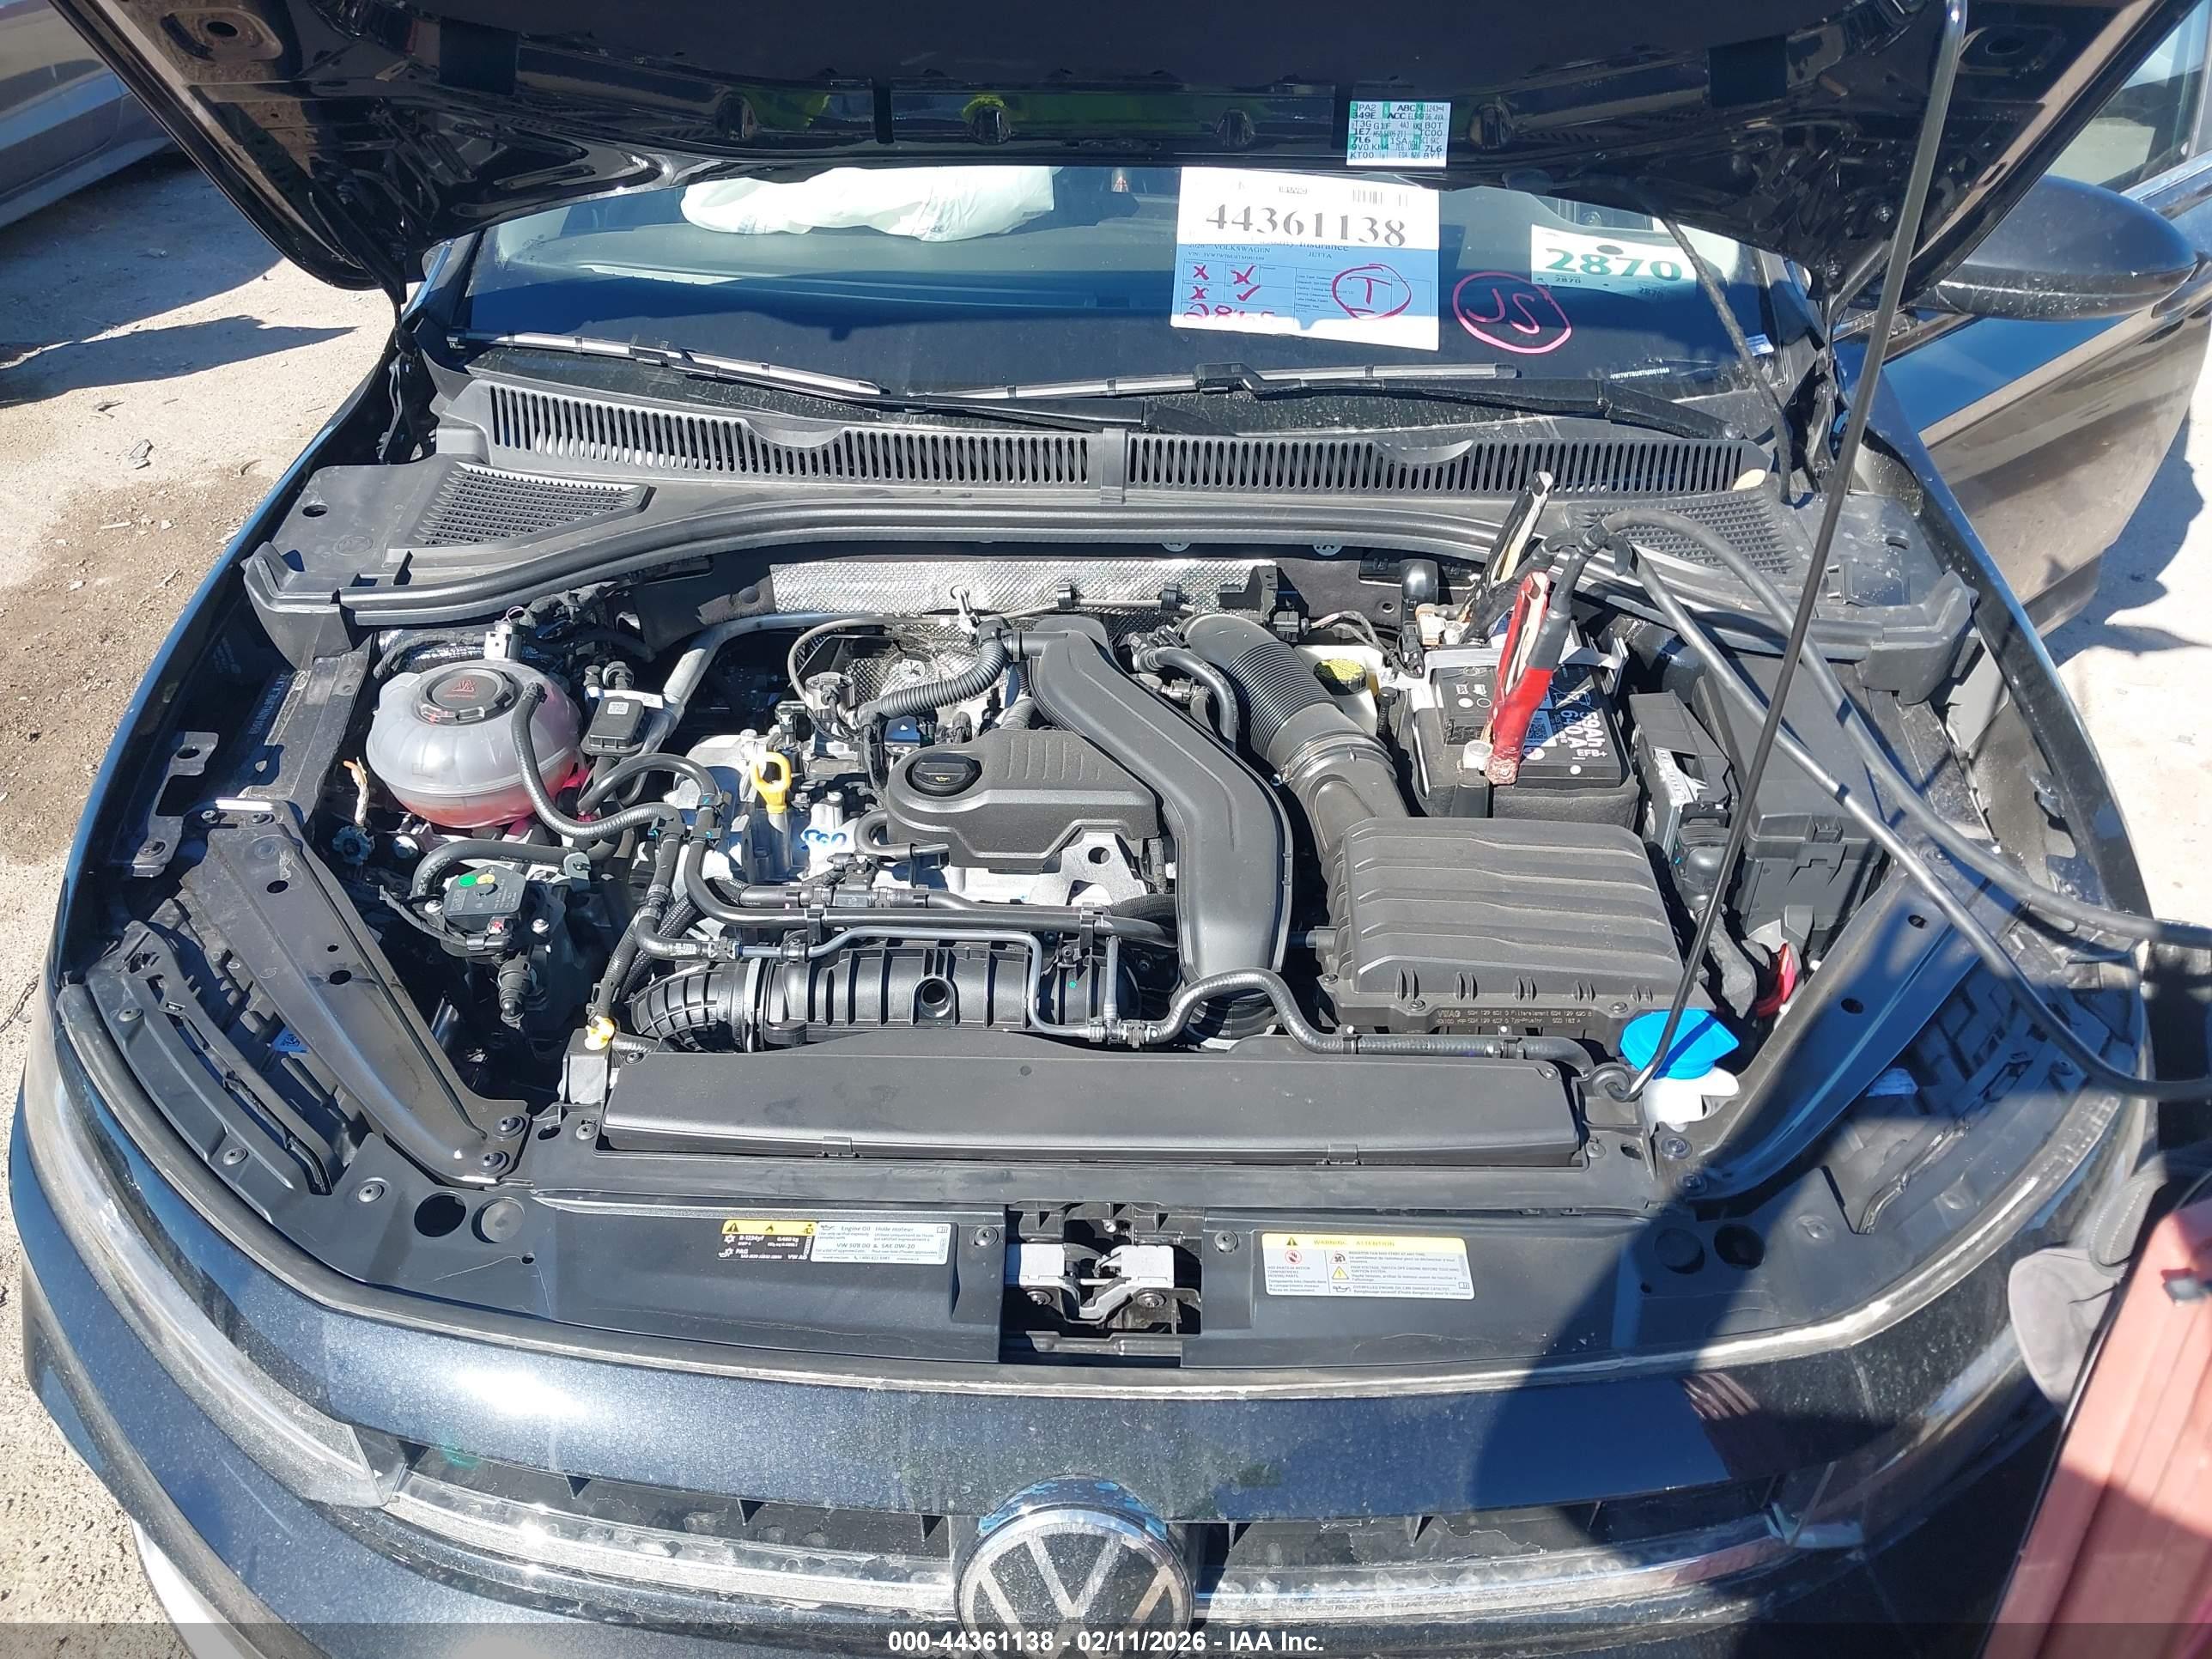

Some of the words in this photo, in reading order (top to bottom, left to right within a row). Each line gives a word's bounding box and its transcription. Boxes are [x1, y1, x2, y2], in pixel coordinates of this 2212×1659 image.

[1206, 204, 1407, 247] 44361138
[1213, 244, 1271, 253] VOLKSWAGEN
[1545, 247, 1683, 282] 2870
